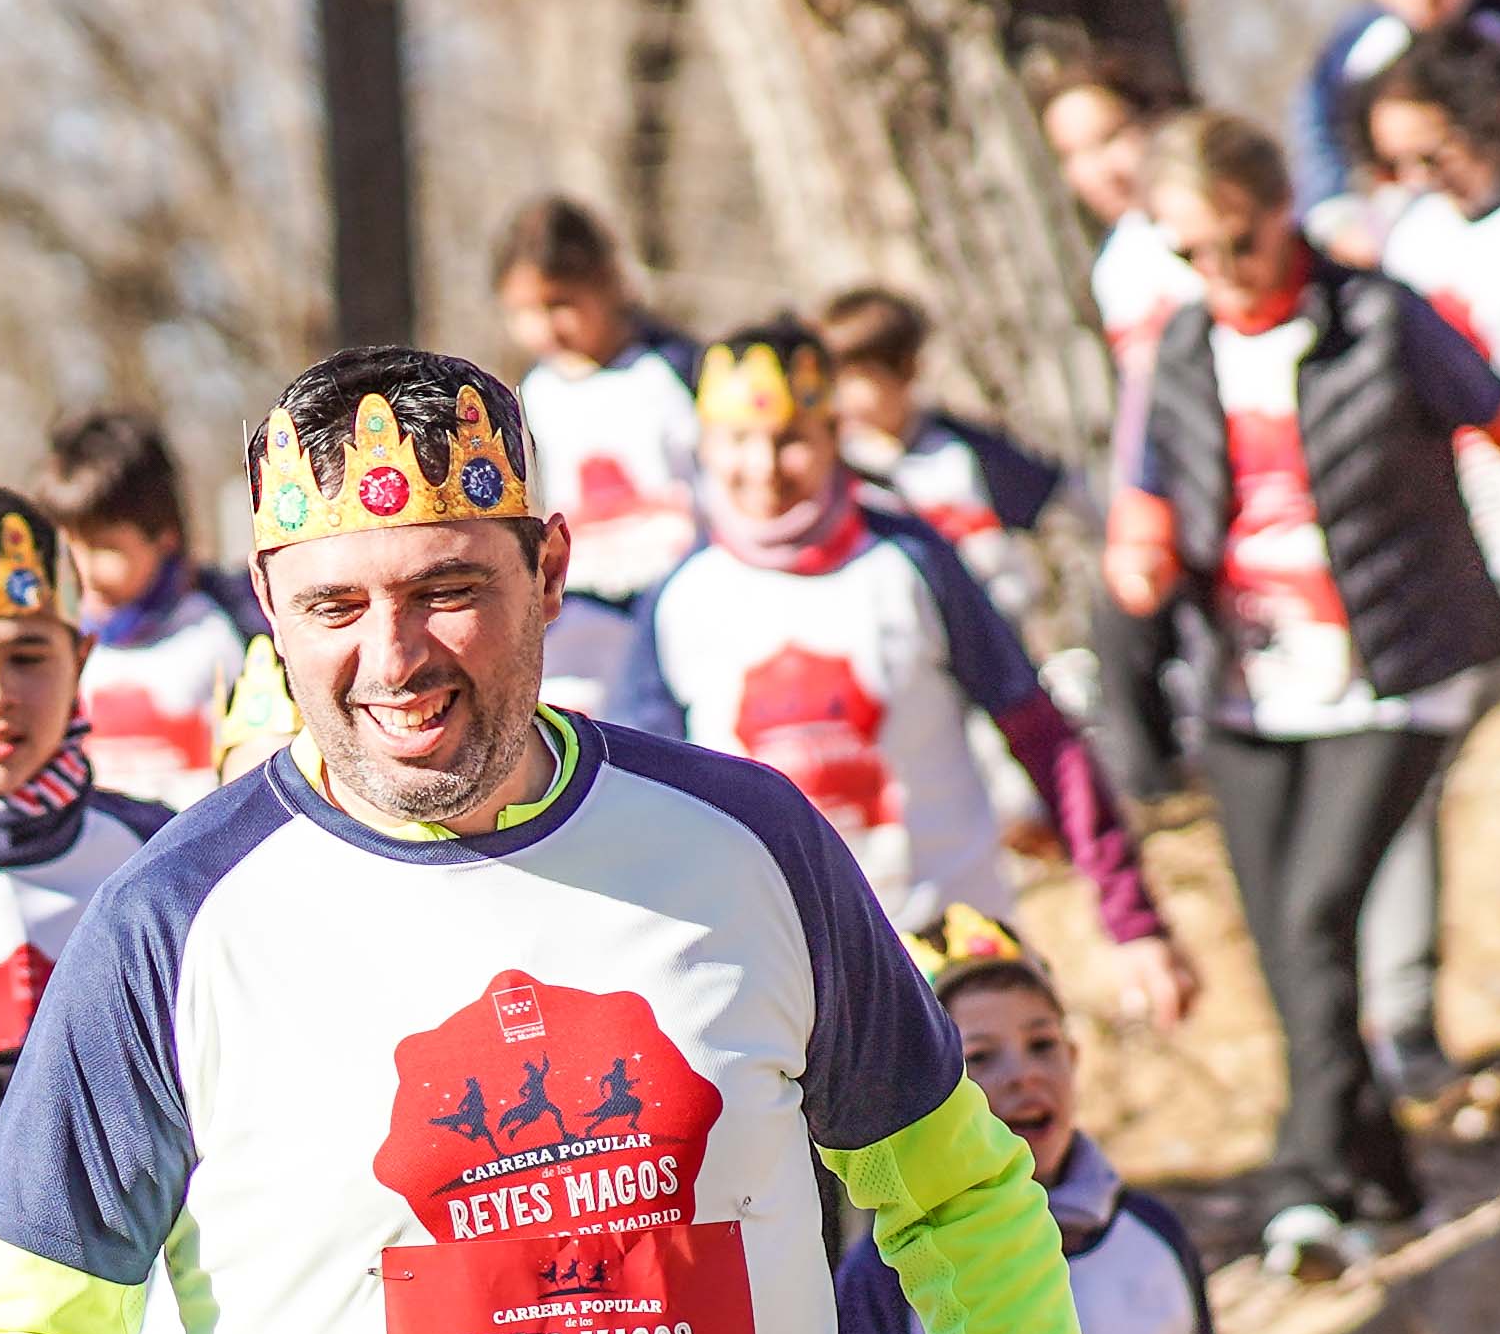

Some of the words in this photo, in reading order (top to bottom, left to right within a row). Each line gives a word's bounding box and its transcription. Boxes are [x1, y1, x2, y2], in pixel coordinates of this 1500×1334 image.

[462, 1147, 558, 1184] CARRERA
[557, 1133, 652, 1160] POPULAR
[541, 1166, 556, 1179] de
[557, 1164, 573, 1176] los
[447, 1182, 553, 1240] REYES
[563, 1155, 679, 1218] MAGOS
[608, 1208, 682, 1233] MADRID
[492, 1301, 577, 1325] CARRERA
[580, 1299, 662, 1314] POPULAR
[564, 1317, 577, 1328] de
[579, 1317, 593, 1328] los
